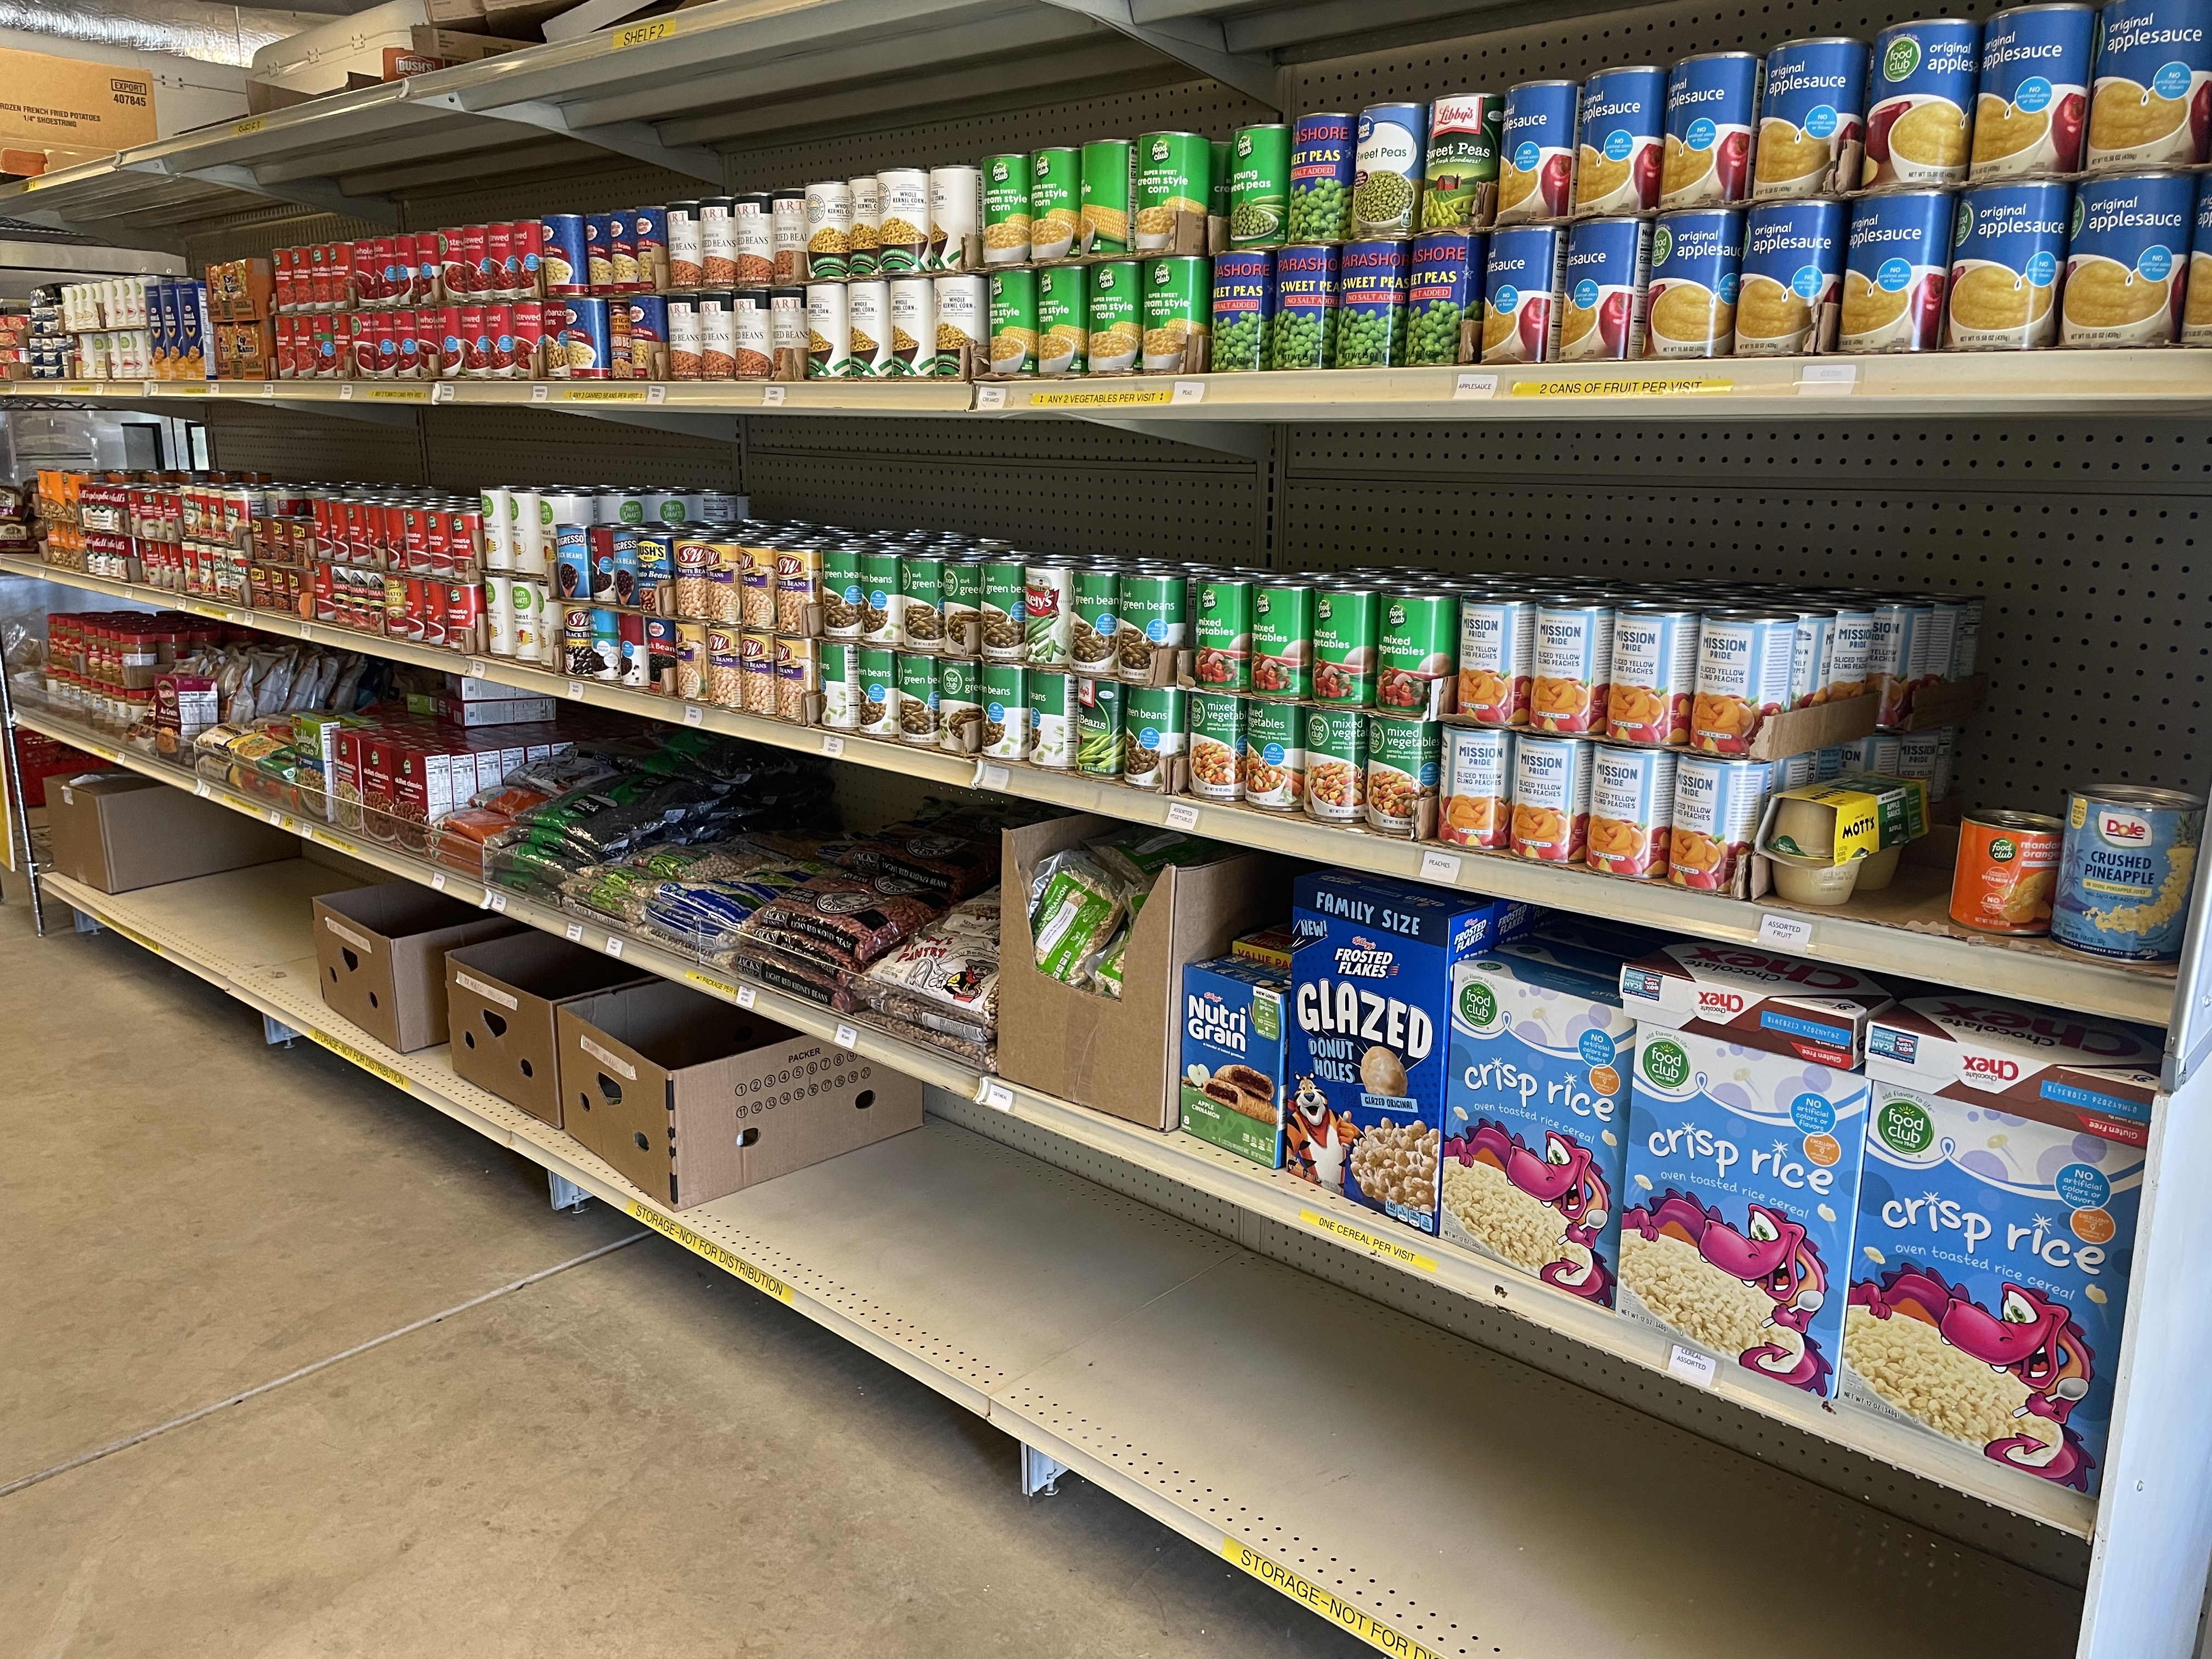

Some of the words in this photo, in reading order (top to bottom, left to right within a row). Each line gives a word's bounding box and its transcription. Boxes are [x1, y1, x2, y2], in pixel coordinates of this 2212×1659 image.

[2109, 12, 2153, 33] original
[623, 26, 656, 46] SHELF
[657, 24, 664, 38] 2
[2108, 27, 2203, 54] applesauce
[1929, 42, 1971, 57] original
[1983, 44, 2062, 71] applesauce
[398, 60, 433, 72] BUSH'S
[1770, 60, 1805, 78] original
[114, 82, 143, 93] EXPORT
[1769, 73, 1846, 97] applesauce
[113, 94, 146, 106] 407845
[23, 106, 49, 116] FRENCH
[50, 110, 69, 118] FRIED
[70, 112, 101, 122] POTATOES
[37, 116, 77, 128] SHOESTRING
[1438, 104, 1474, 127] Libby's
[1309, 149, 1341, 162] PEAS
[1233, 170, 1258, 182] young
[1148, 185, 1169, 194] corn
[1246, 179, 1271, 191] peas
[1980, 203, 2027, 221] original
[2091, 196, 2138, 214] original
[1754, 222, 1793, 239] original
[1978, 217, 2065, 238] applesauce
[2089, 212, 2181, 233] applesauce
[1678, 230, 1719, 244] original
[1753, 235, 1832, 255] applesauce
[1849, 226, 1922, 249] applesauce
[675, 242, 697, 251] BEANS
[1424, 270, 1457, 284] PEAS
[1233, 285, 1263, 297] PEAS
[1280, 280, 1316, 292] SWEET
[678, 333, 699, 341] BEANS
[1458, 382, 1492, 391] APPLESAUCE
[1539, 384, 1547, 394] 2
[1549, 383, 1582, 394] CANS
[1583, 383, 1601, 393] OF
[1603, 382, 1640, 393] FRUIT
[1641, 382, 1667, 393] PER
[1670, 381, 1703, 391] VISIT
[1047, 394, 1063, 404] ANY
[1063, 394, 1069, 403] 2
[1070, 393, 1118, 404] VEGETABLES
[1118, 393, 1135, 403] PER
[1136, 392, 1156, 402] VISIT
[1123, 600, 1145, 611] green
[1147, 600, 1175, 611] beans
[1539, 624, 1581, 637] MISSION
[1383, 635, 1410, 646] mixed
[1547, 637, 1568, 646] PRIDE
[1702, 636, 1746, 652] MISSION
[1709, 650, 1732, 659] PRIDE
[1139, 710, 1168, 720] beans
[1387, 726, 1420, 737] mixed
[1386, 736, 1440, 749] vegetables
[1459, 744, 1503, 759] MISSION
[1469, 757, 1491, 766] PRIDE
[1170, 812, 1193, 823] VEGETABLES
[1173, 807, 1193, 816] ASSORTED
[1842, 816, 1875, 839] MOTT'S
[2106, 820, 2146, 837] Dole
[1428, 859, 1451, 869] PEACHES
[2090, 850, 2152, 870] CRUSHED
[2085, 864, 2155, 885] PINEAPPLE
[1316, 891, 1376, 924] FAMILY
[1382, 910, 1421, 936] SIZE
[1454, 919, 1487, 946] FROSTED
[1768, 921, 1801, 933] ASSORTED
[1773, 930, 1793, 940] FRUIT
[1455, 931, 1485, 953] FLAKES
[737, 957, 761, 971] JACK'S
[1335, 947, 1394, 966] FROSTED
[1337, 962, 1389, 978] FLAKES
[765, 970, 781, 981] LIGHT
[782, 977, 791, 986] RED
[792, 981, 810, 996] KIDNEY
[811, 990, 828, 1003] BEANS
[1466, 989, 1491, 1008] food
[1697, 991, 1744, 1013] Chex
[1188, 995, 1246, 1035] Nutri
[1466, 1003, 1489, 1018] club
[1296, 979, 1434, 1059] GLAZED
[1188, 1018, 1246, 1052] Grain
[1590, 1034, 1604, 1043] NO
[1803, 1025, 1840, 1040] 29JAN2026
[788, 1047, 821, 1063] PACKER
[1308, 1038, 1355, 1061] DONUT
[1651, 1047, 1683, 1067] food
[314, 1030, 353, 1056] STORAGE-NOT
[352, 1051, 365, 1065] FOR
[365, 1058, 404, 1086] DISTRIBUTION
[1313, 1058, 1355, 1083] HOLES
[1651, 1061, 1679, 1079] club
[1962, 1054, 2019, 1081] Chex
[1464, 1057, 1538, 1108] crisp
[1548, 1071, 1615, 1122] rice
[1191, 1104, 1221, 1119] CINNAMON
[1198, 1100, 1215, 1111] APPLE
[1805, 1098, 1822, 1109] NO
[1474, 1102, 1496, 1111] oven
[1498, 1102, 1537, 1121] toasted
[1541, 1115, 1559, 1128] rice
[1562, 1124, 1595, 1142] cereal
[1888, 1109, 1925, 1132] food
[1887, 1125, 1921, 1144] club
[1648, 1121, 1740, 1178] crisp
[1752, 1139, 1834, 1196] rice
[2074, 1168, 2095, 1181] NO
[2061, 1184, 2089, 1199] colors
[2090, 1190, 2101, 1200] or
[2063, 1176, 2103, 1192] artificial
[1660, 1170, 1686, 1182] oven
[1690, 1171, 1738, 1193] toasted
[1742, 1186, 1765, 1202] rice
[1769, 1197, 1809, 1220] cereal
[2065, 1192, 2097, 1207] flavors
[1318, 1217, 1336, 1233] ONE
[1336, 1224, 1372, 1246] CEREAL
[1372, 1237, 1392, 1252] PER
[1393, 1245, 1417, 1262] VISIT
[1881, 1190, 1993, 1255] crisp
[2006, 1212, 2107, 1276] rice
[635, 1205, 699, 1248] STORAGE-NOT
[698, 1239, 718, 1260] FOR
[719, 1250, 783, 1296] DISTRIBUTION
[1895, 1243, 1927, 1256] oven
[1931, 1245, 1990, 1272] toasted
[1994, 1263, 2023, 1282] rice
[2027, 1275, 2076, 1301] cereal
[1675, 1355, 1707, 1371] ASSORTED
[1240, 1549, 1368, 1630] STORAGE-NOT
[1370, 1621, 1409, 1657] FOR
